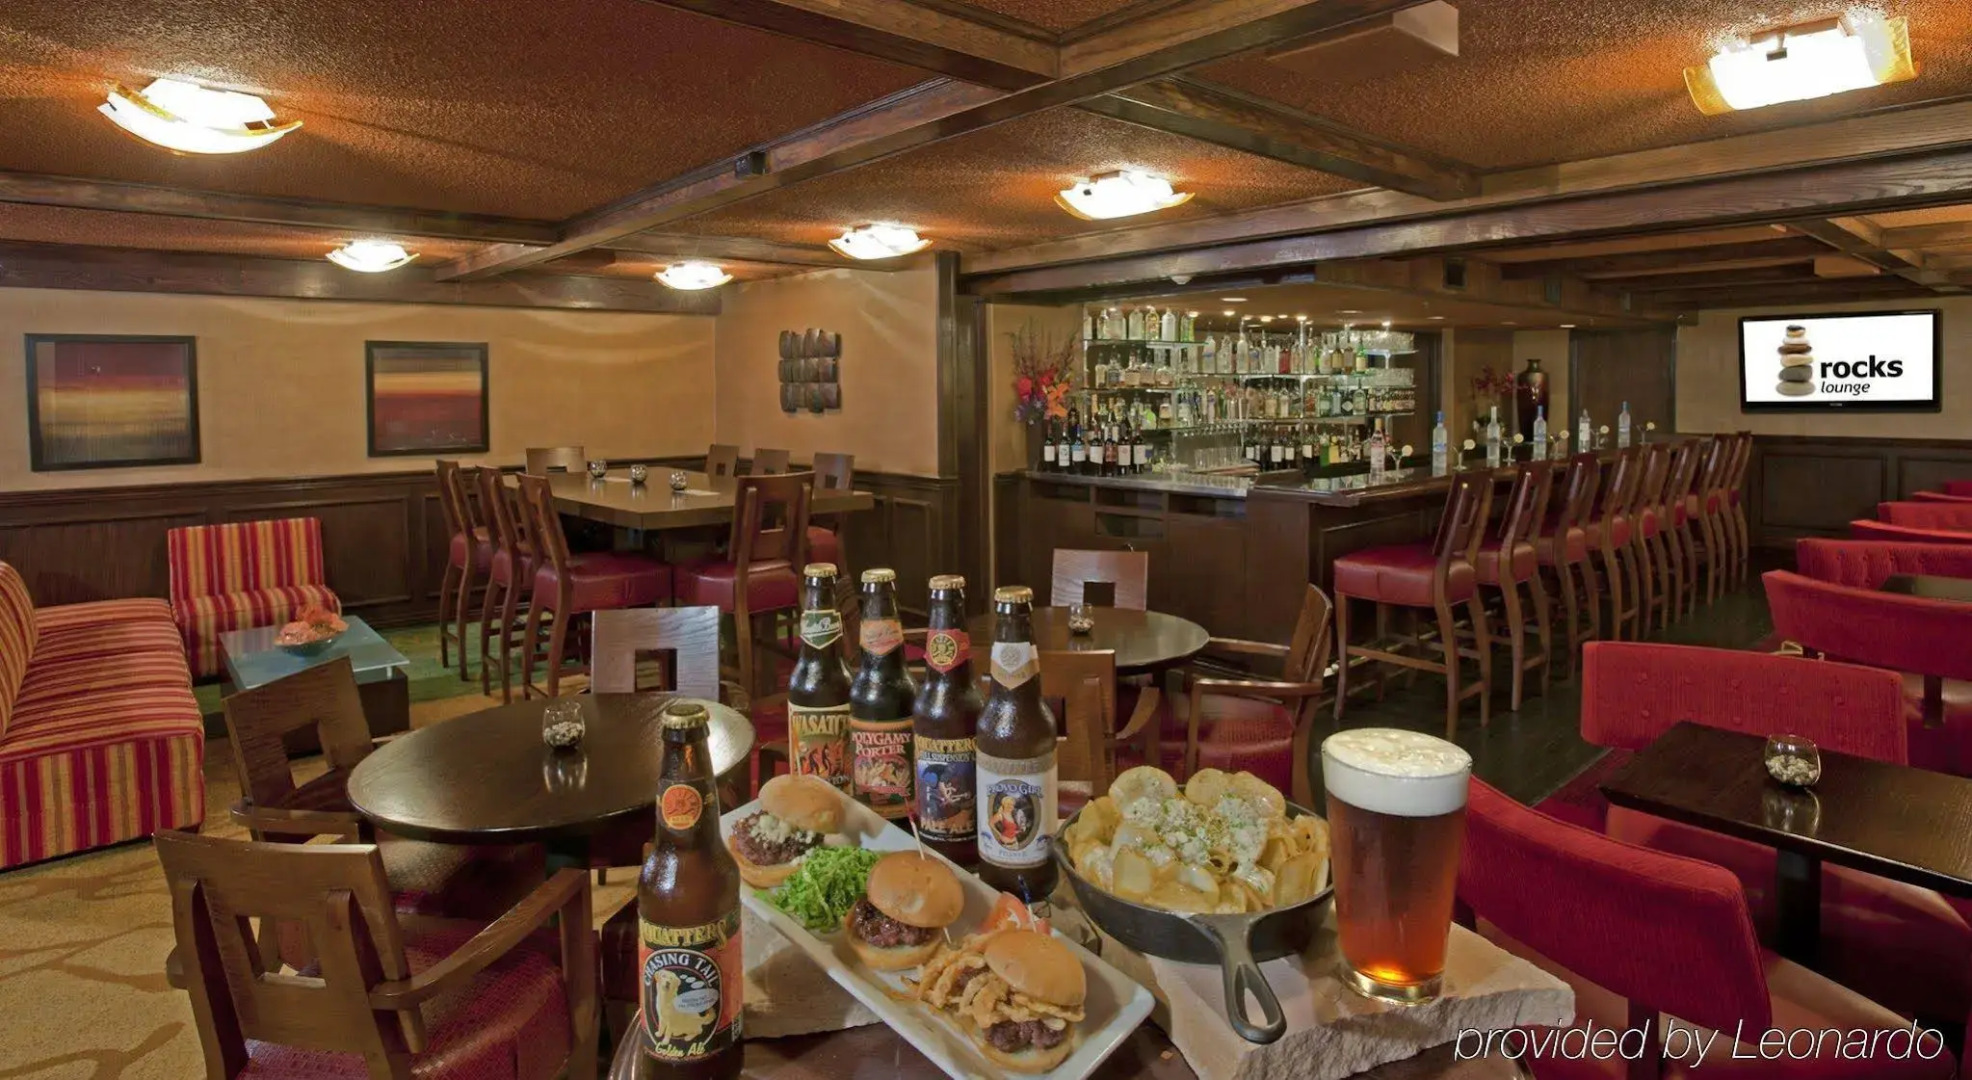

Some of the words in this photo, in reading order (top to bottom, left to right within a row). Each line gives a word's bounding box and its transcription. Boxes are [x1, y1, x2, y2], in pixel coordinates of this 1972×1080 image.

[1820, 354, 1904, 379] rocks
[1820, 381, 1871, 396] lounge
[852, 731, 911, 746] POLYGAMY
[855, 743, 906, 758] PORTER
[644, 952, 690, 986] CHASING
[694, 957, 720, 988] TAIL
[686, 1041, 707, 1057] Ale
